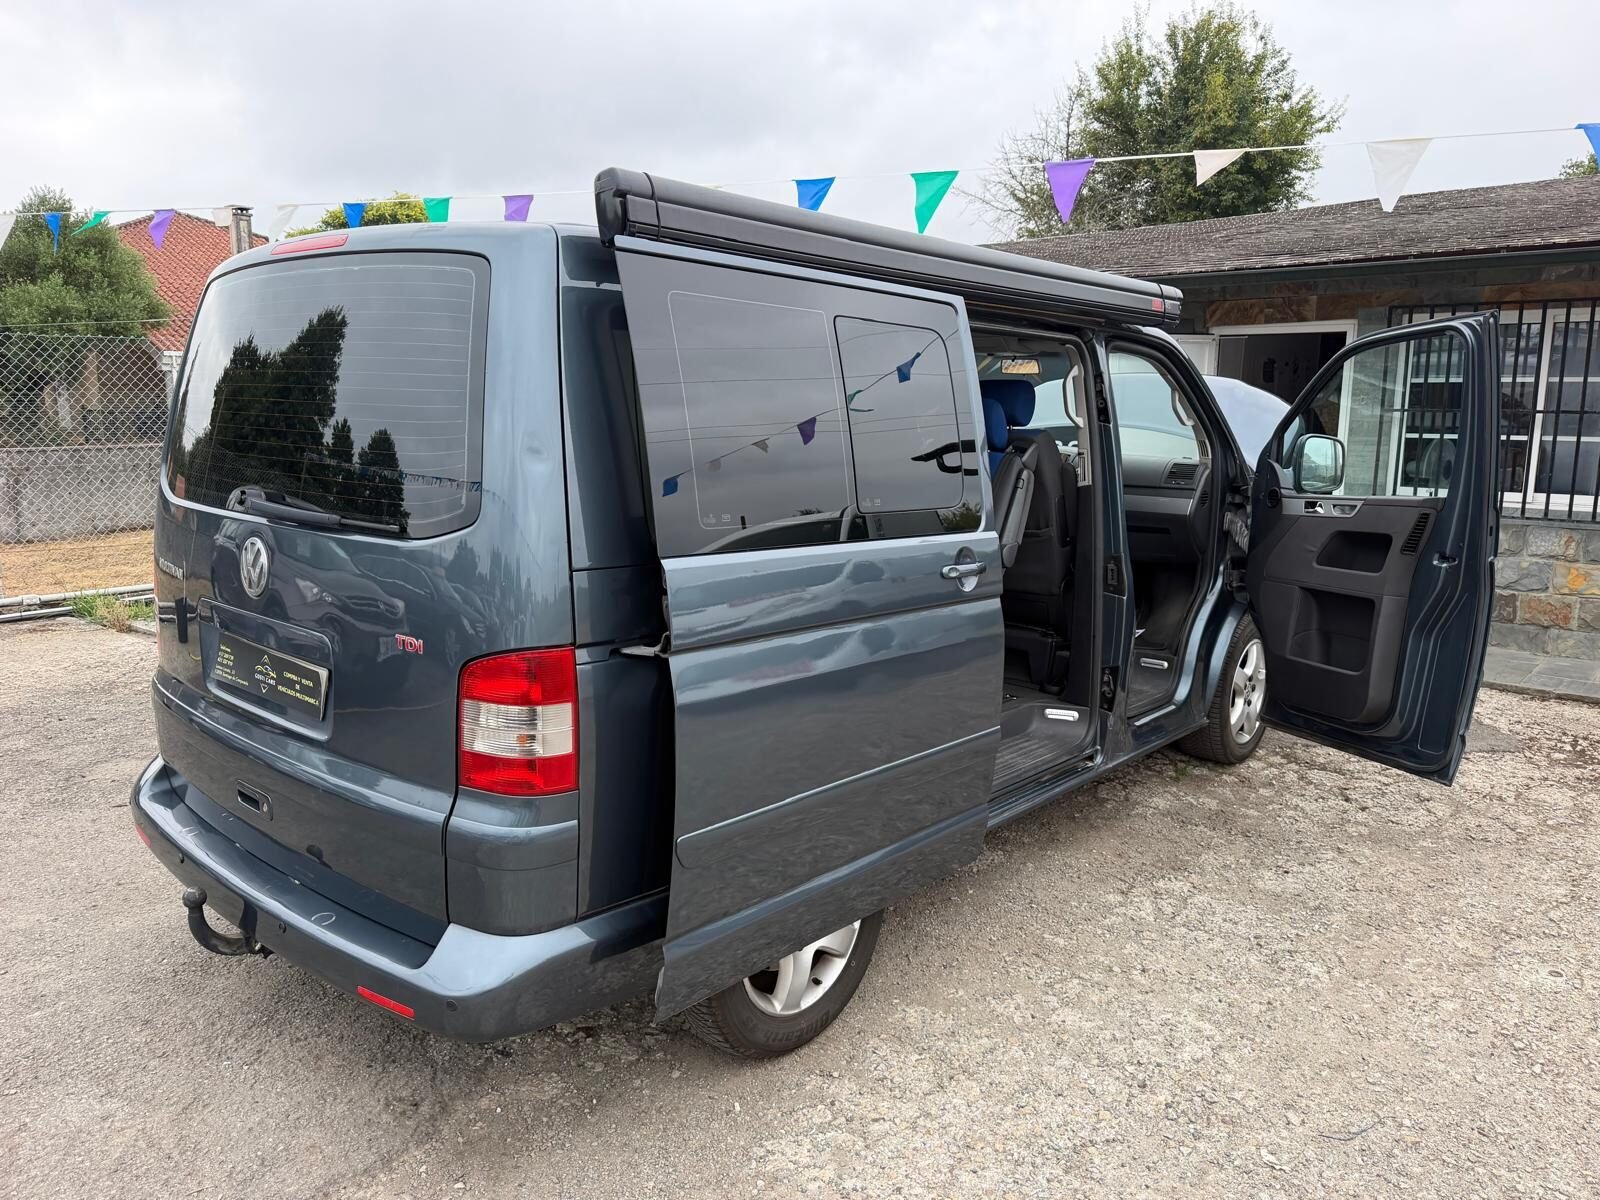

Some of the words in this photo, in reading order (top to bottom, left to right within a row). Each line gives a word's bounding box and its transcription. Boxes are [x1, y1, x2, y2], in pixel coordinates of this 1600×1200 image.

[395, 633, 424, 655] TDI
[265, 676, 276, 686] CARS
[283, 671, 298, 681] COMPRA
[301, 677, 314, 688] VENTA
